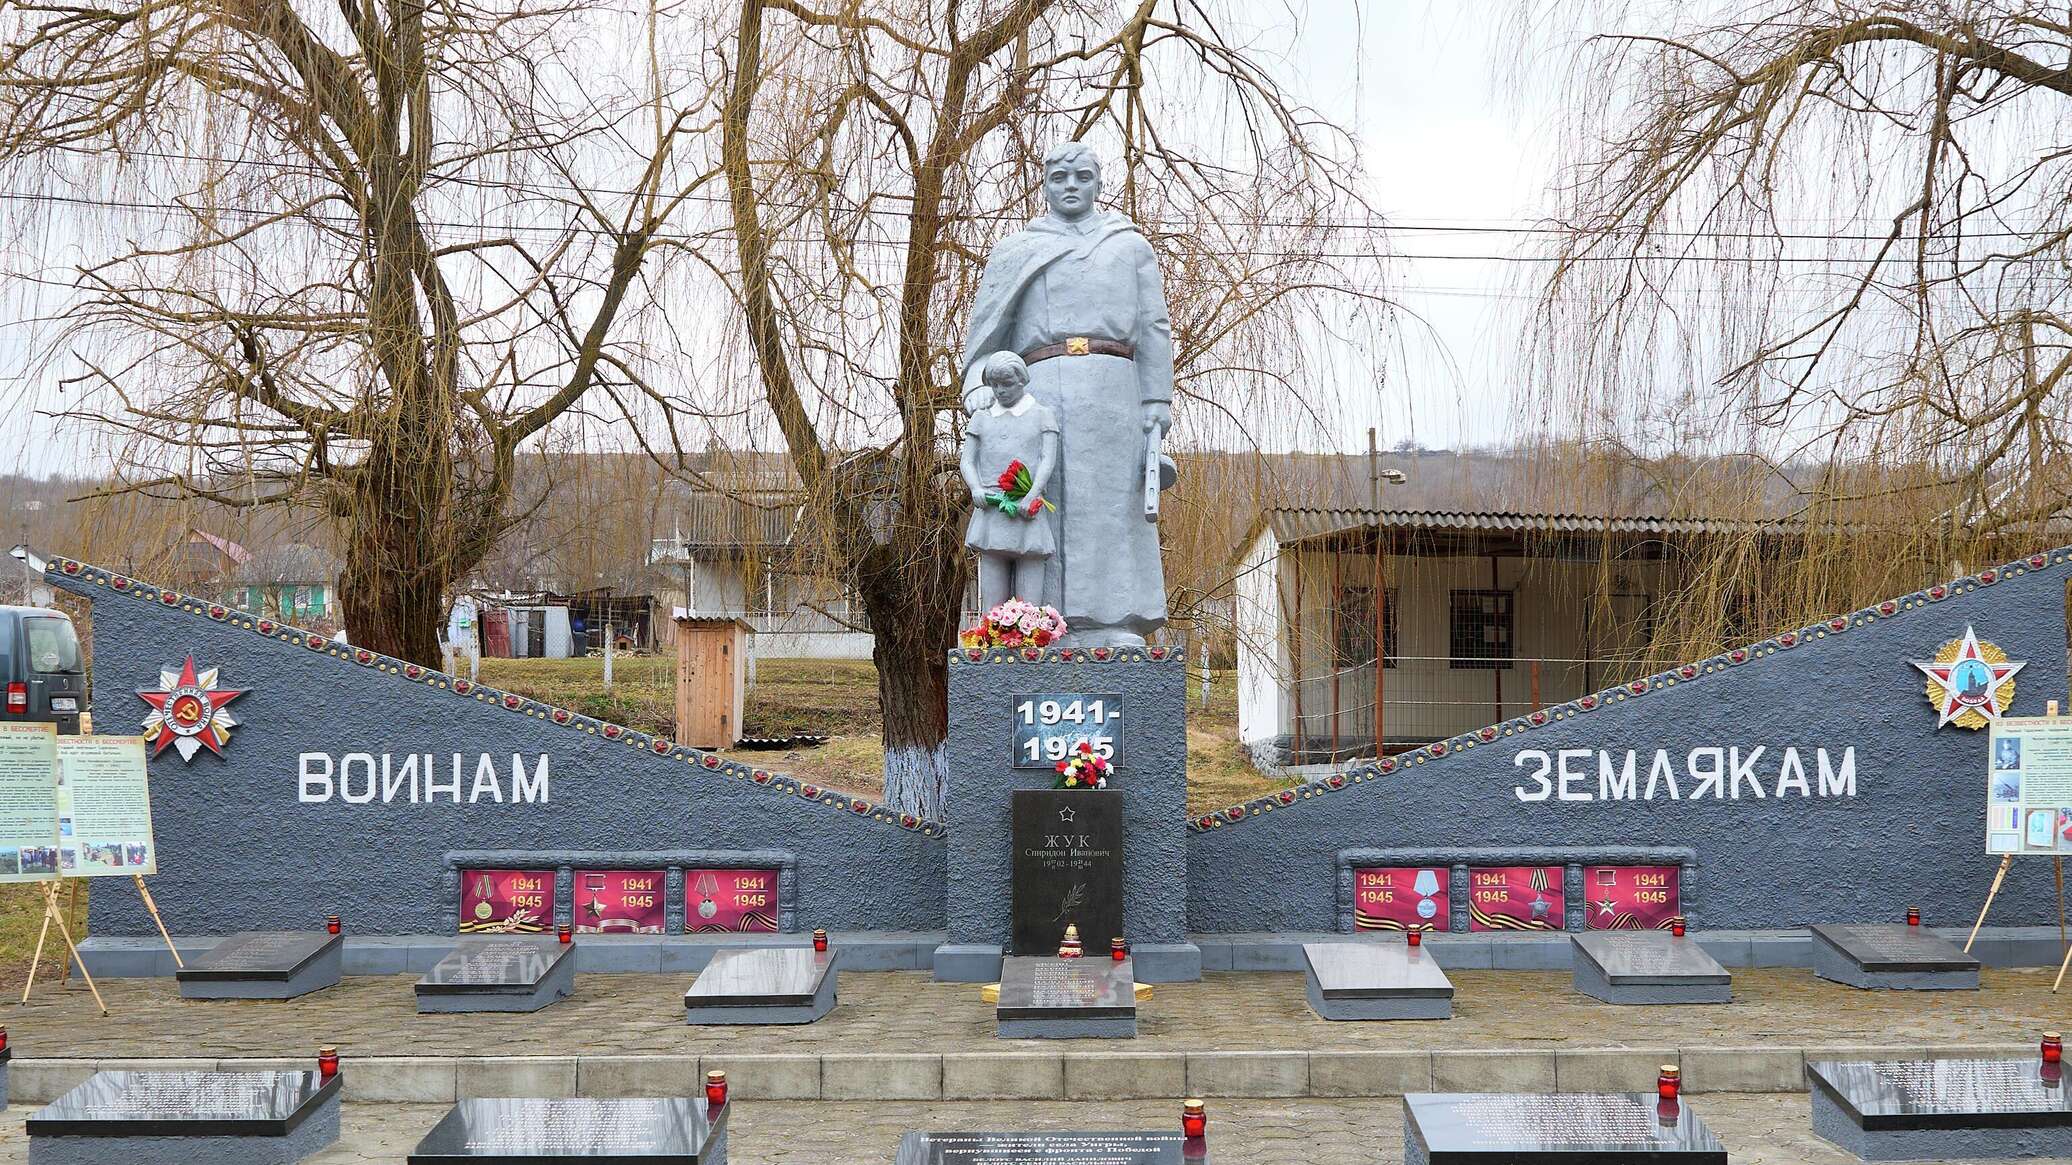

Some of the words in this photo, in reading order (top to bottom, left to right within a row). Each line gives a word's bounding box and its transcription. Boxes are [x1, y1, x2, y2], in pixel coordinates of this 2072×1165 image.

[1017, 700, 1120, 724] 1941-
[299, 752, 549, 804] ВОИНАМ
[1514, 745, 1856, 801] ЗЕМЛЯКАМ
[1025, 848, 1066, 859] Спиридон
[1070, 847, 1111, 857] Иванович
[511, 878, 542, 890] 1941
[623, 878, 654, 890] 1941
[734, 877, 765, 889] 1941
[1361, 873, 1392, 885] 1941
[1475, 873, 1506, 885] 1941
[1633, 873, 1664, 885] 1941
[510, 895, 542, 907] 1945
[621, 895, 653, 907] 1945
[733, 895, 765, 907] 1945
[1361, 890, 1393, 902] 1945
[1475, 890, 1507, 902] 1945
[1633, 890, 1665, 902] 1945
